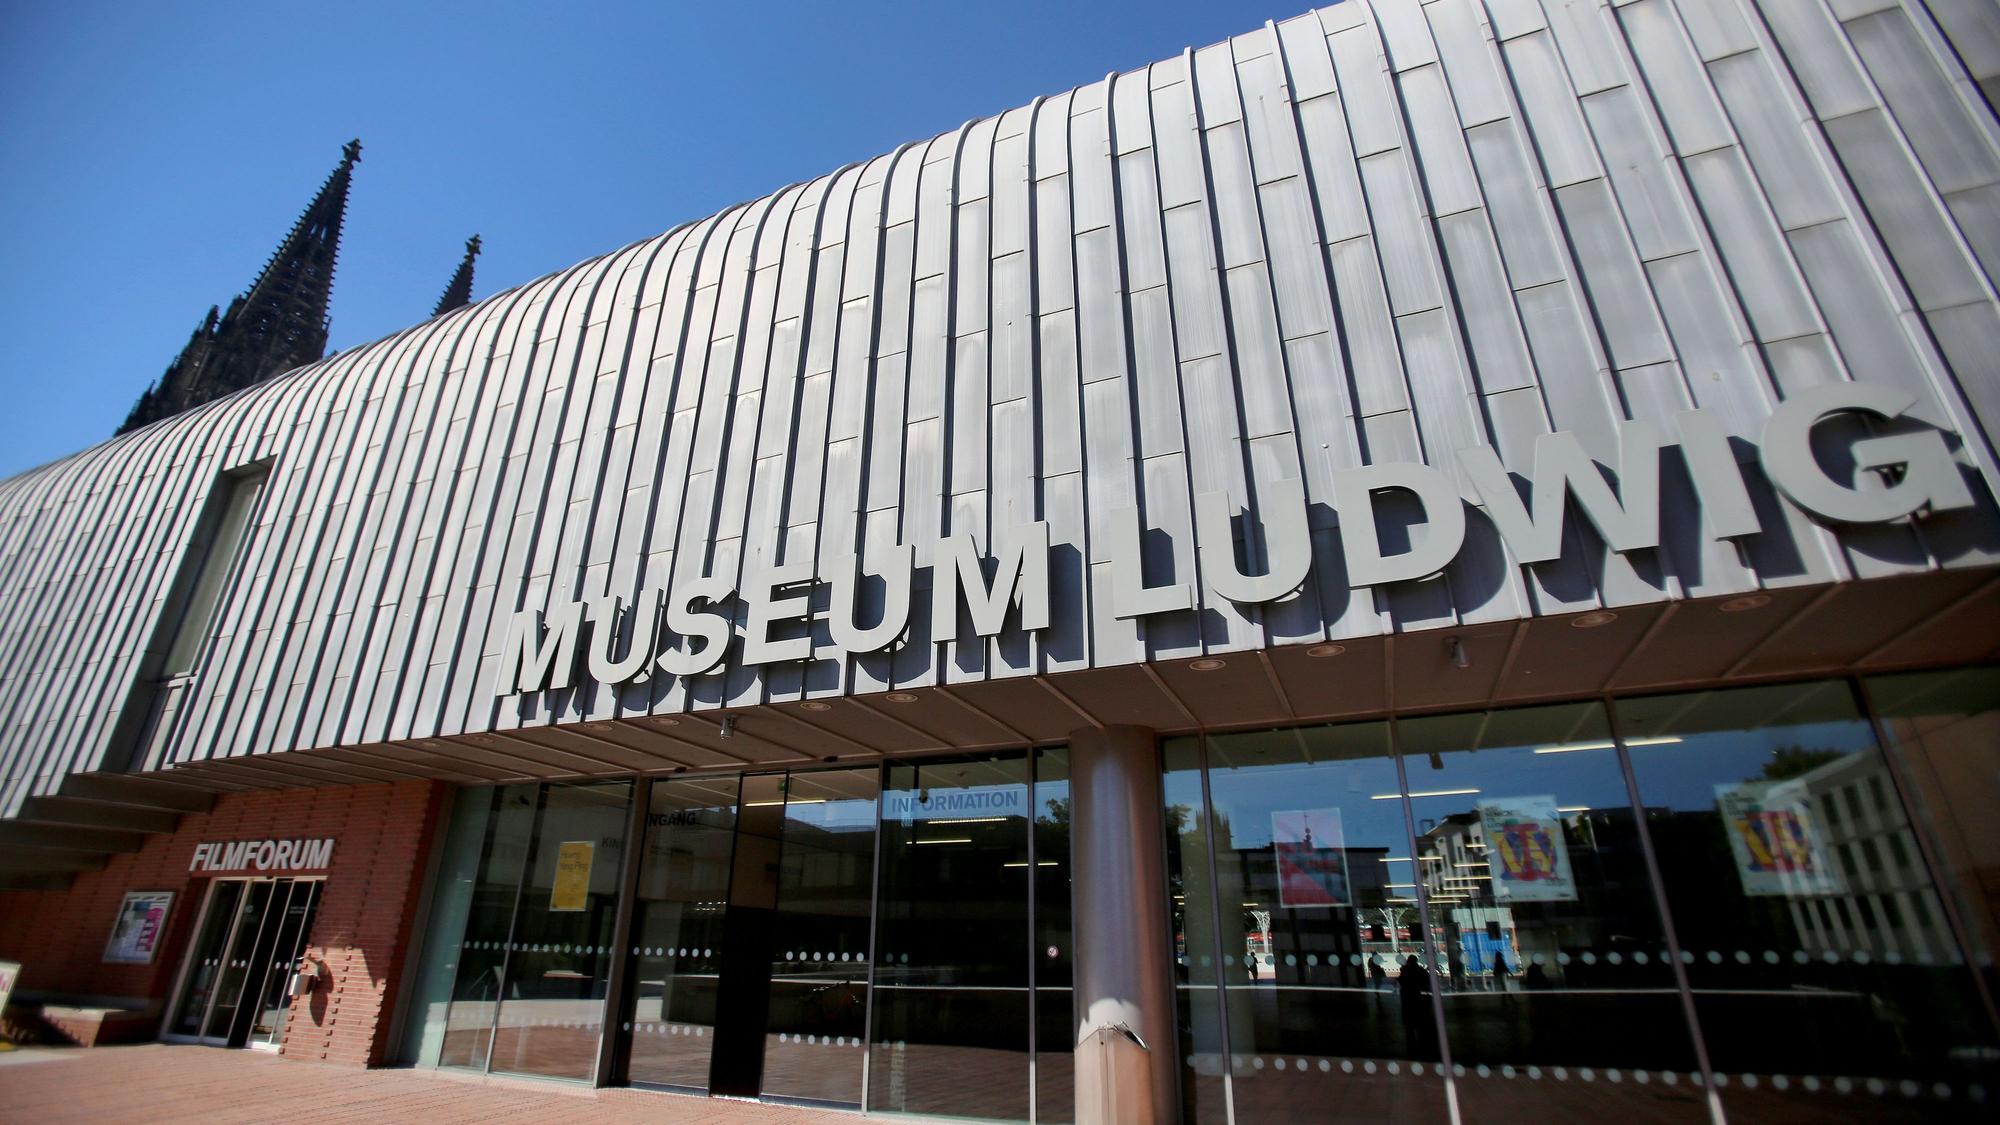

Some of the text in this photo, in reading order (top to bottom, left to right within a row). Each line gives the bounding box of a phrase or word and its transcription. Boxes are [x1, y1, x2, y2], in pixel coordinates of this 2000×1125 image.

[496, 380, 1976, 697] MUSEUM LUDWIG
[892, 791, 1018, 813] INFORMATION
[189, 838, 335, 872] FILMFORUM
